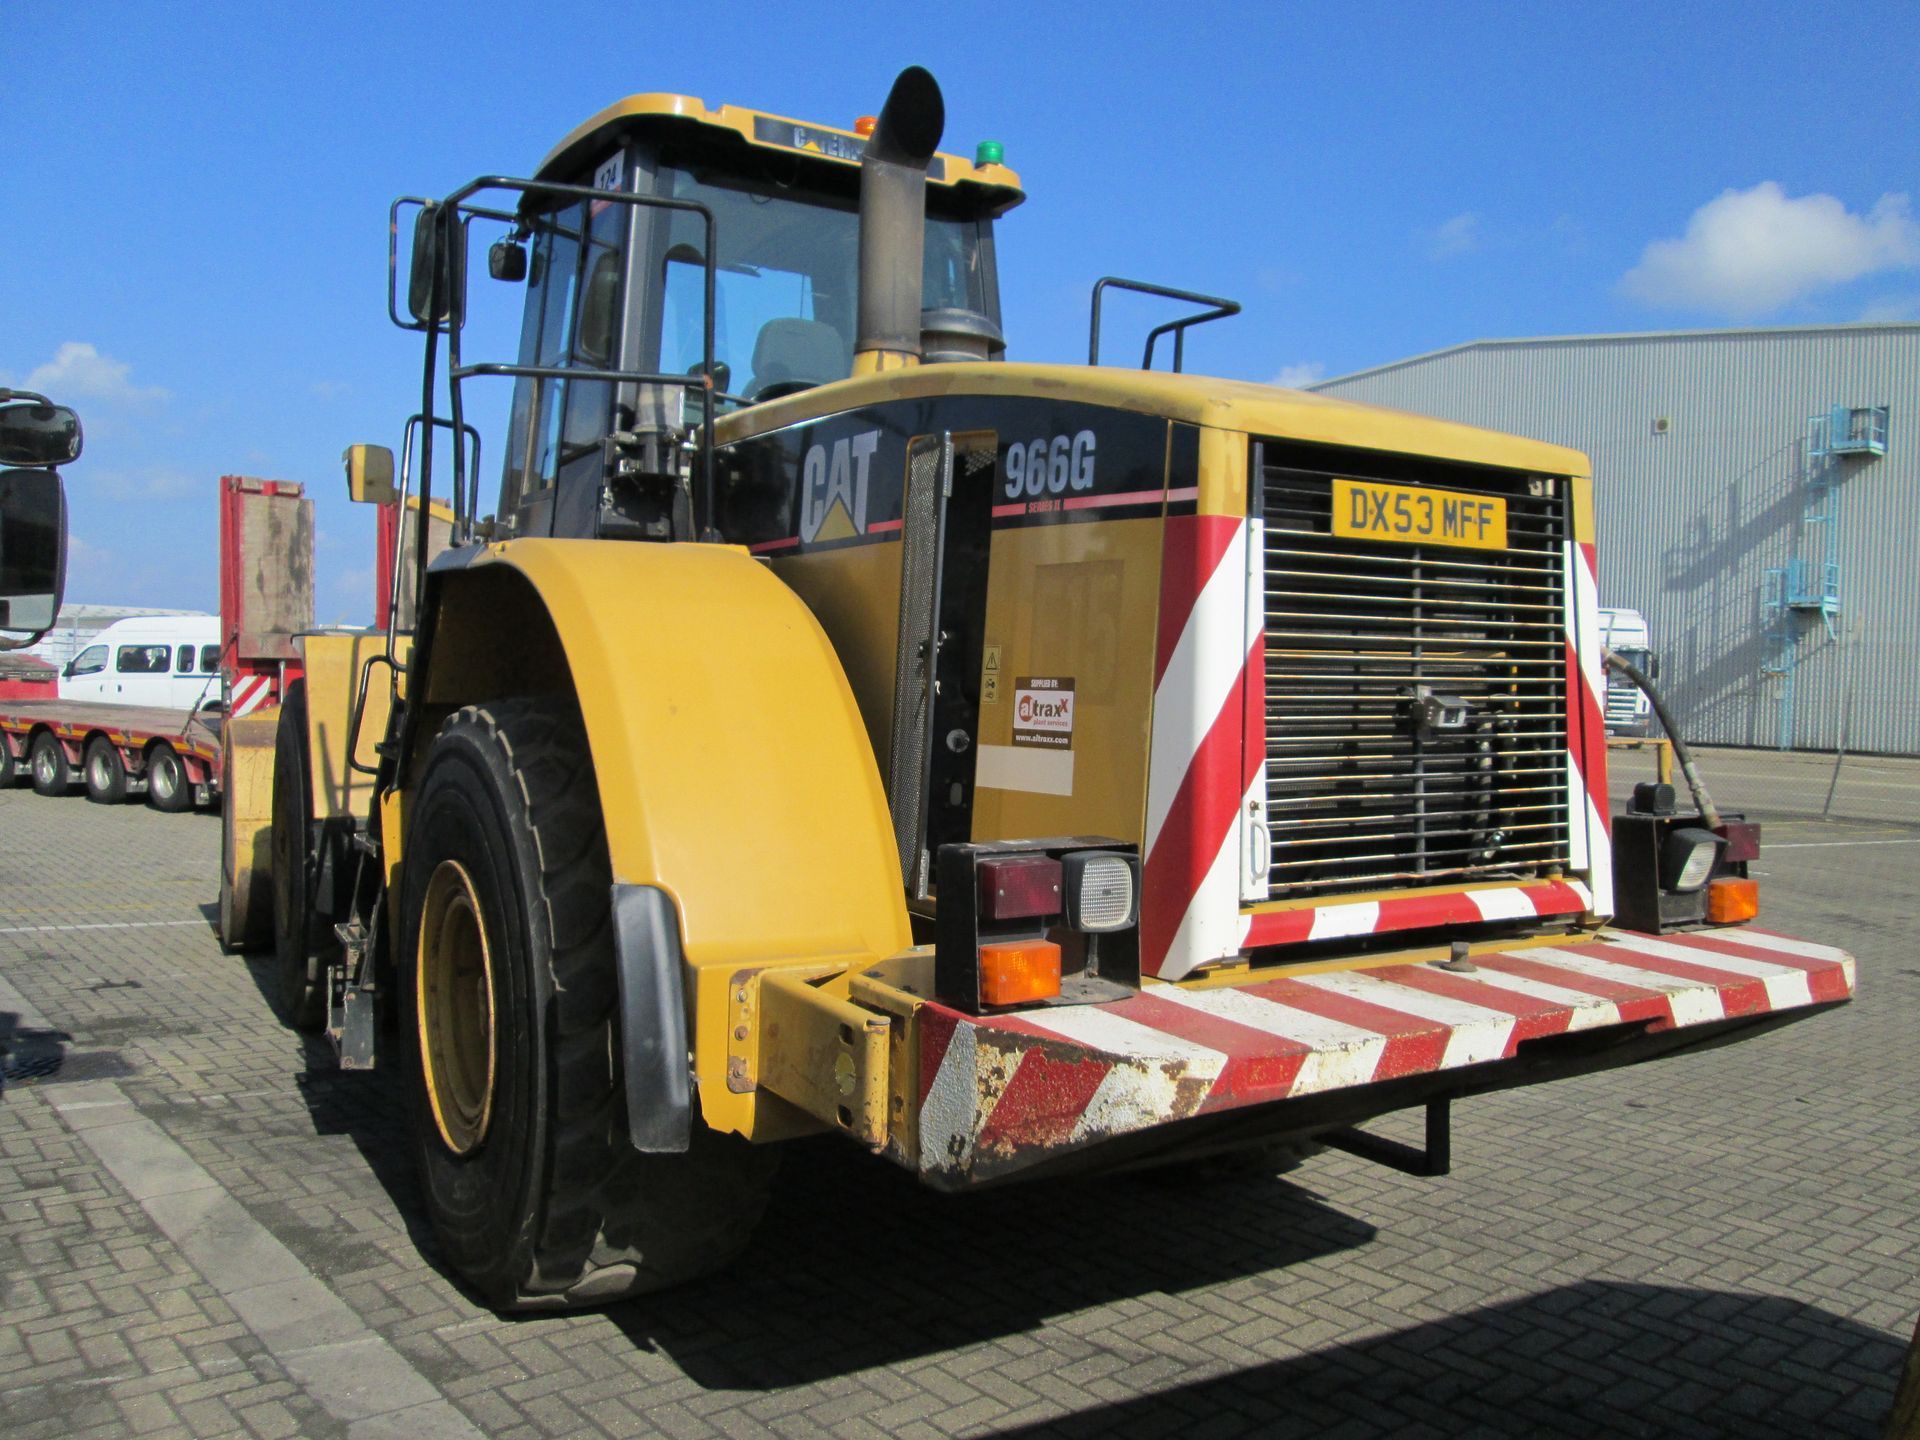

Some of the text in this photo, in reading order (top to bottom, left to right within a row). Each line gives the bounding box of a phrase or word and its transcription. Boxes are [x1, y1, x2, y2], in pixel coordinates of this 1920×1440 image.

[801, 430, 878, 543] CAT
[1005, 429, 1096, 498] 966G
[1350, 487, 1494, 541] DX53 MFF
[1015, 734, 1069, 744] www.altraxx.com
[1033, 719, 1047, 727] plant
